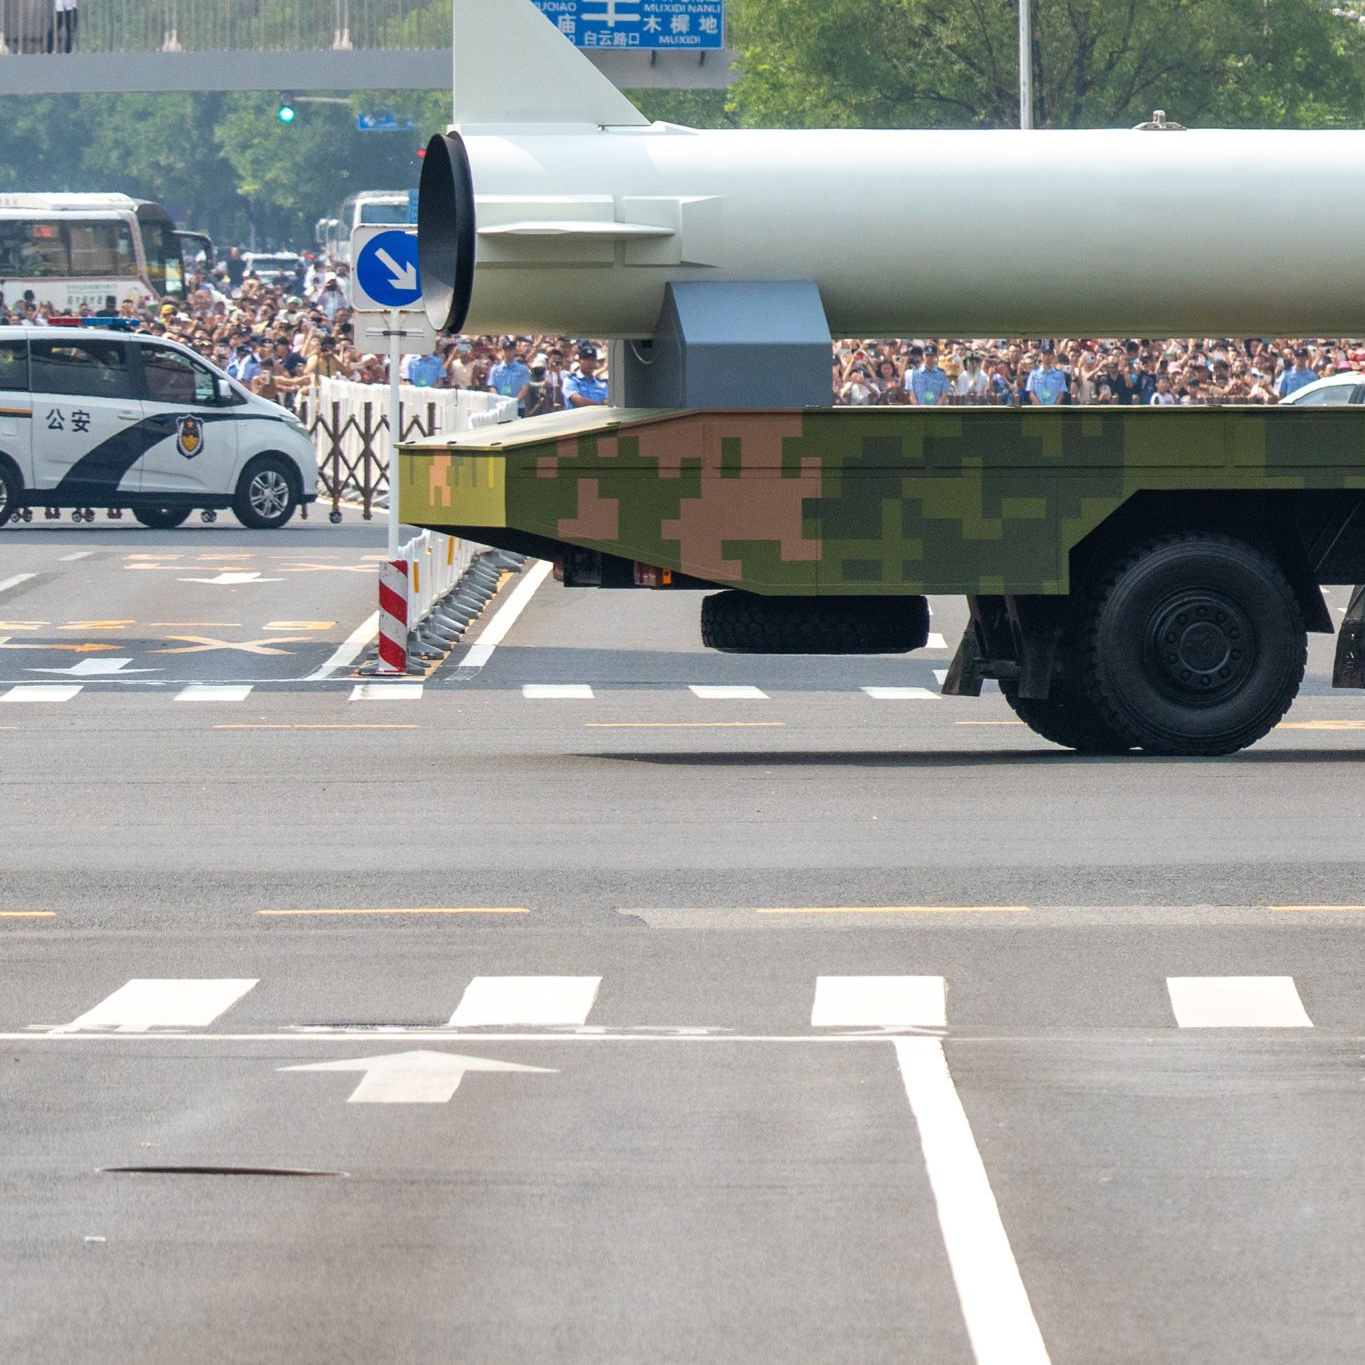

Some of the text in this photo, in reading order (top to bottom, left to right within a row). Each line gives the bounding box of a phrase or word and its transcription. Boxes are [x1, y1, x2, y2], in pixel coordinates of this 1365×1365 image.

[644, 4, 721, 14] MUXIDI NANLI
[584, 31, 640, 46] 白云路口
[659, 35, 701, 45] MUXIDI
[46, 408, 91, 433] 公安
